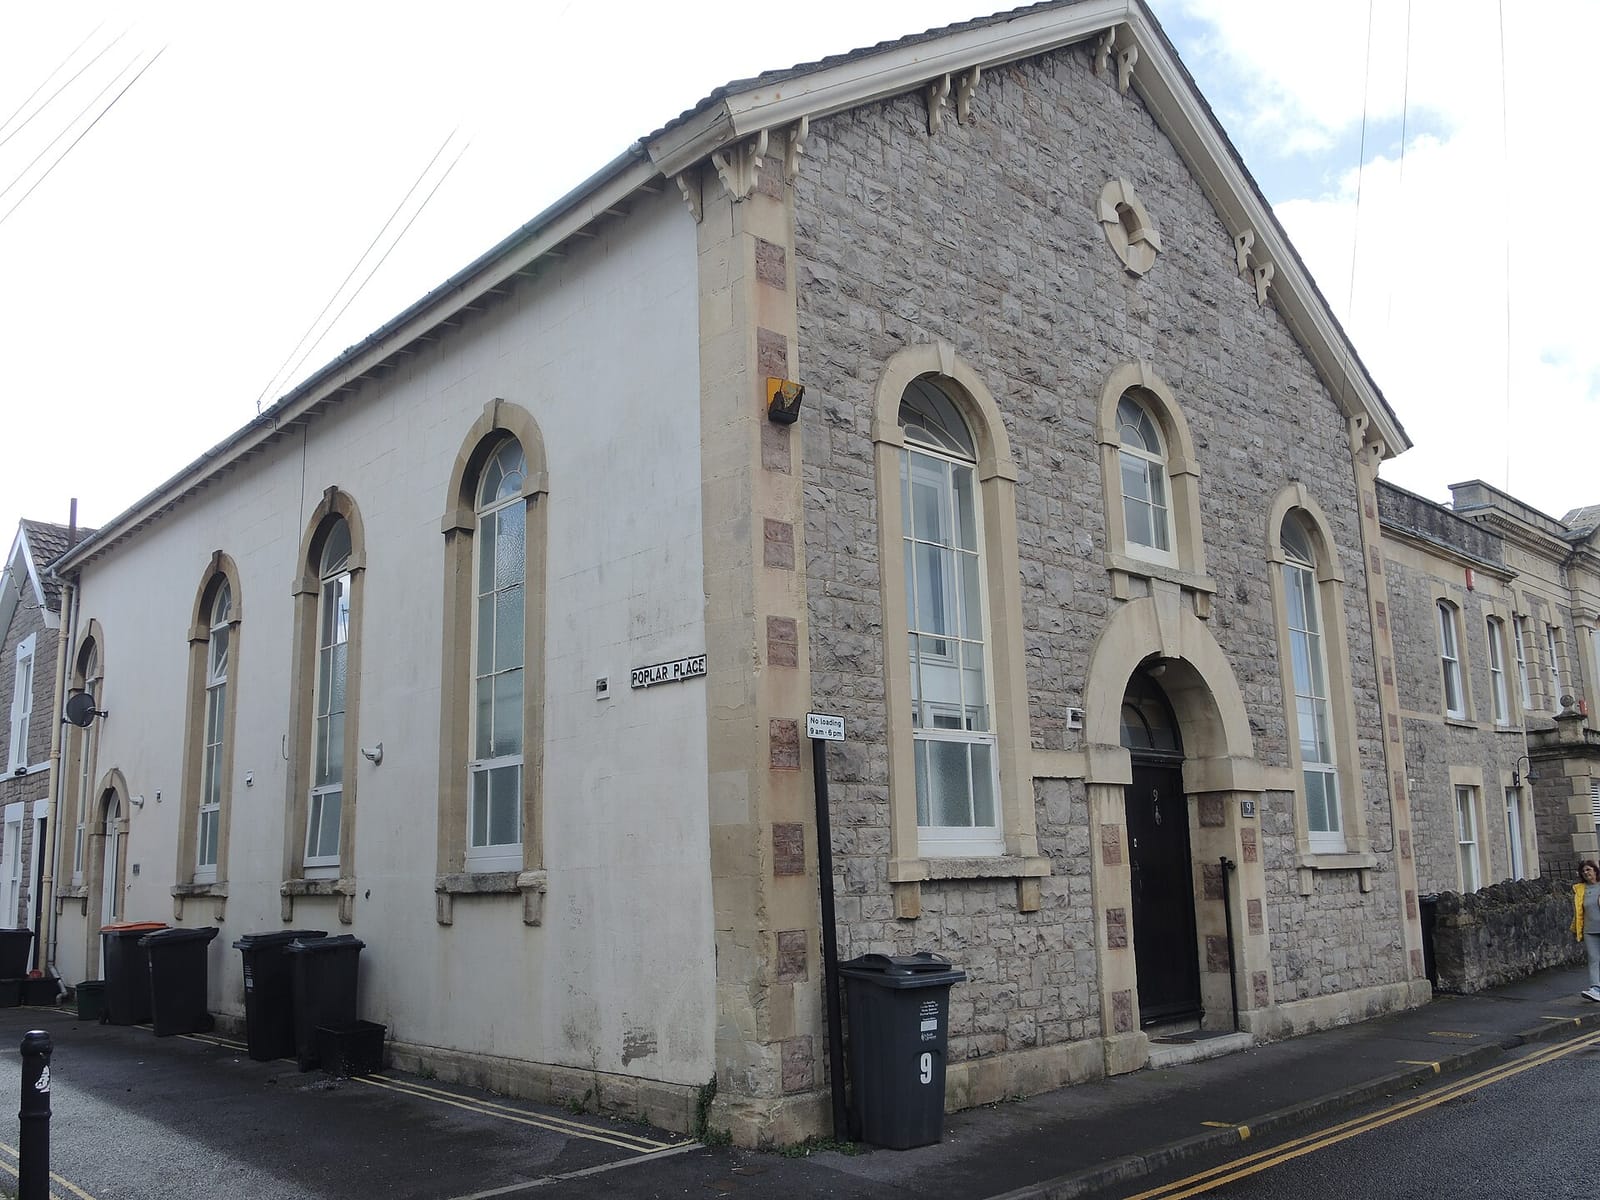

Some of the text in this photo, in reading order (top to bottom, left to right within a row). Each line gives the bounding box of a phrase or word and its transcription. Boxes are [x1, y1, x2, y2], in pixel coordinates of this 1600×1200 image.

[632, 658, 705, 686] POPLAR PLACE
[810, 717, 842, 728] No loading
[1246, 802, 1252, 813] 9
[920, 1052, 932, 1085] 9
